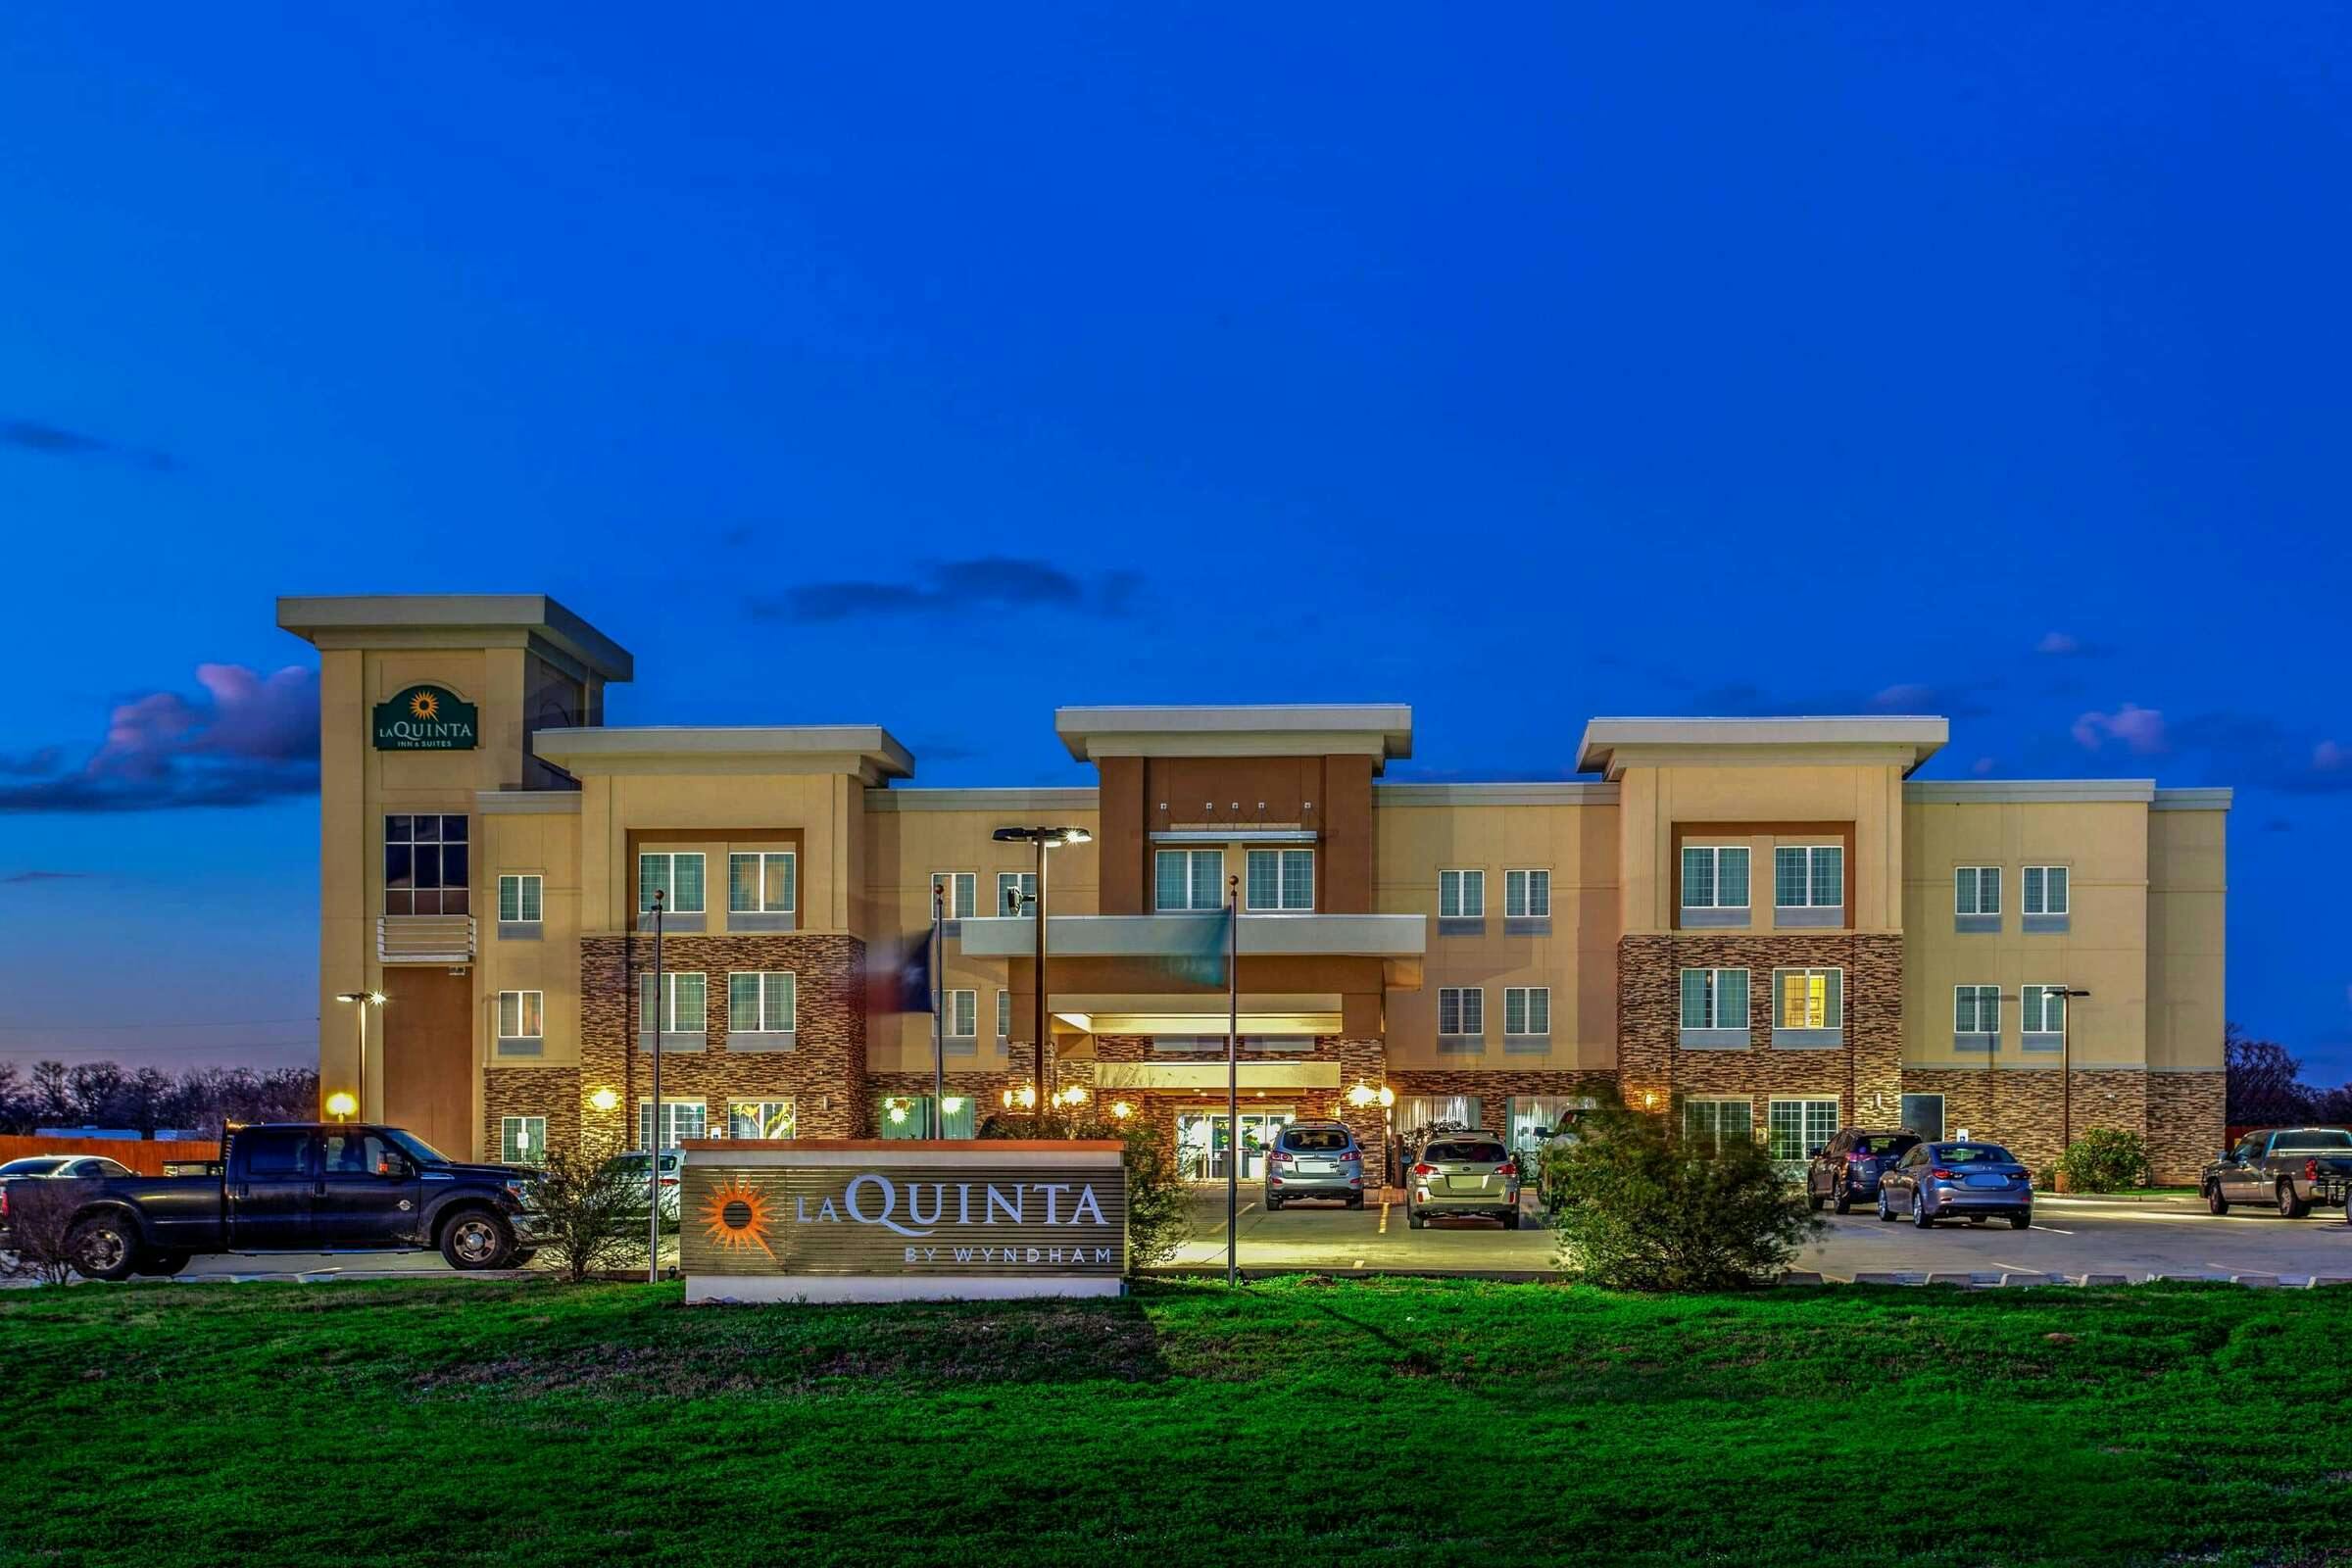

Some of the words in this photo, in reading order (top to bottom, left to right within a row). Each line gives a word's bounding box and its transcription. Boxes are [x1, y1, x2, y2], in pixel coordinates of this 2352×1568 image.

[379, 728, 393, 737] LA
[393, 721, 472, 741] QUINTA
[795, 1196, 843, 1224] LA
[845, 1174, 1110, 1238] QUINTA
[905, 1247, 938, 1264] BY
[953, 1247, 1112, 1264] WYNDHAM
